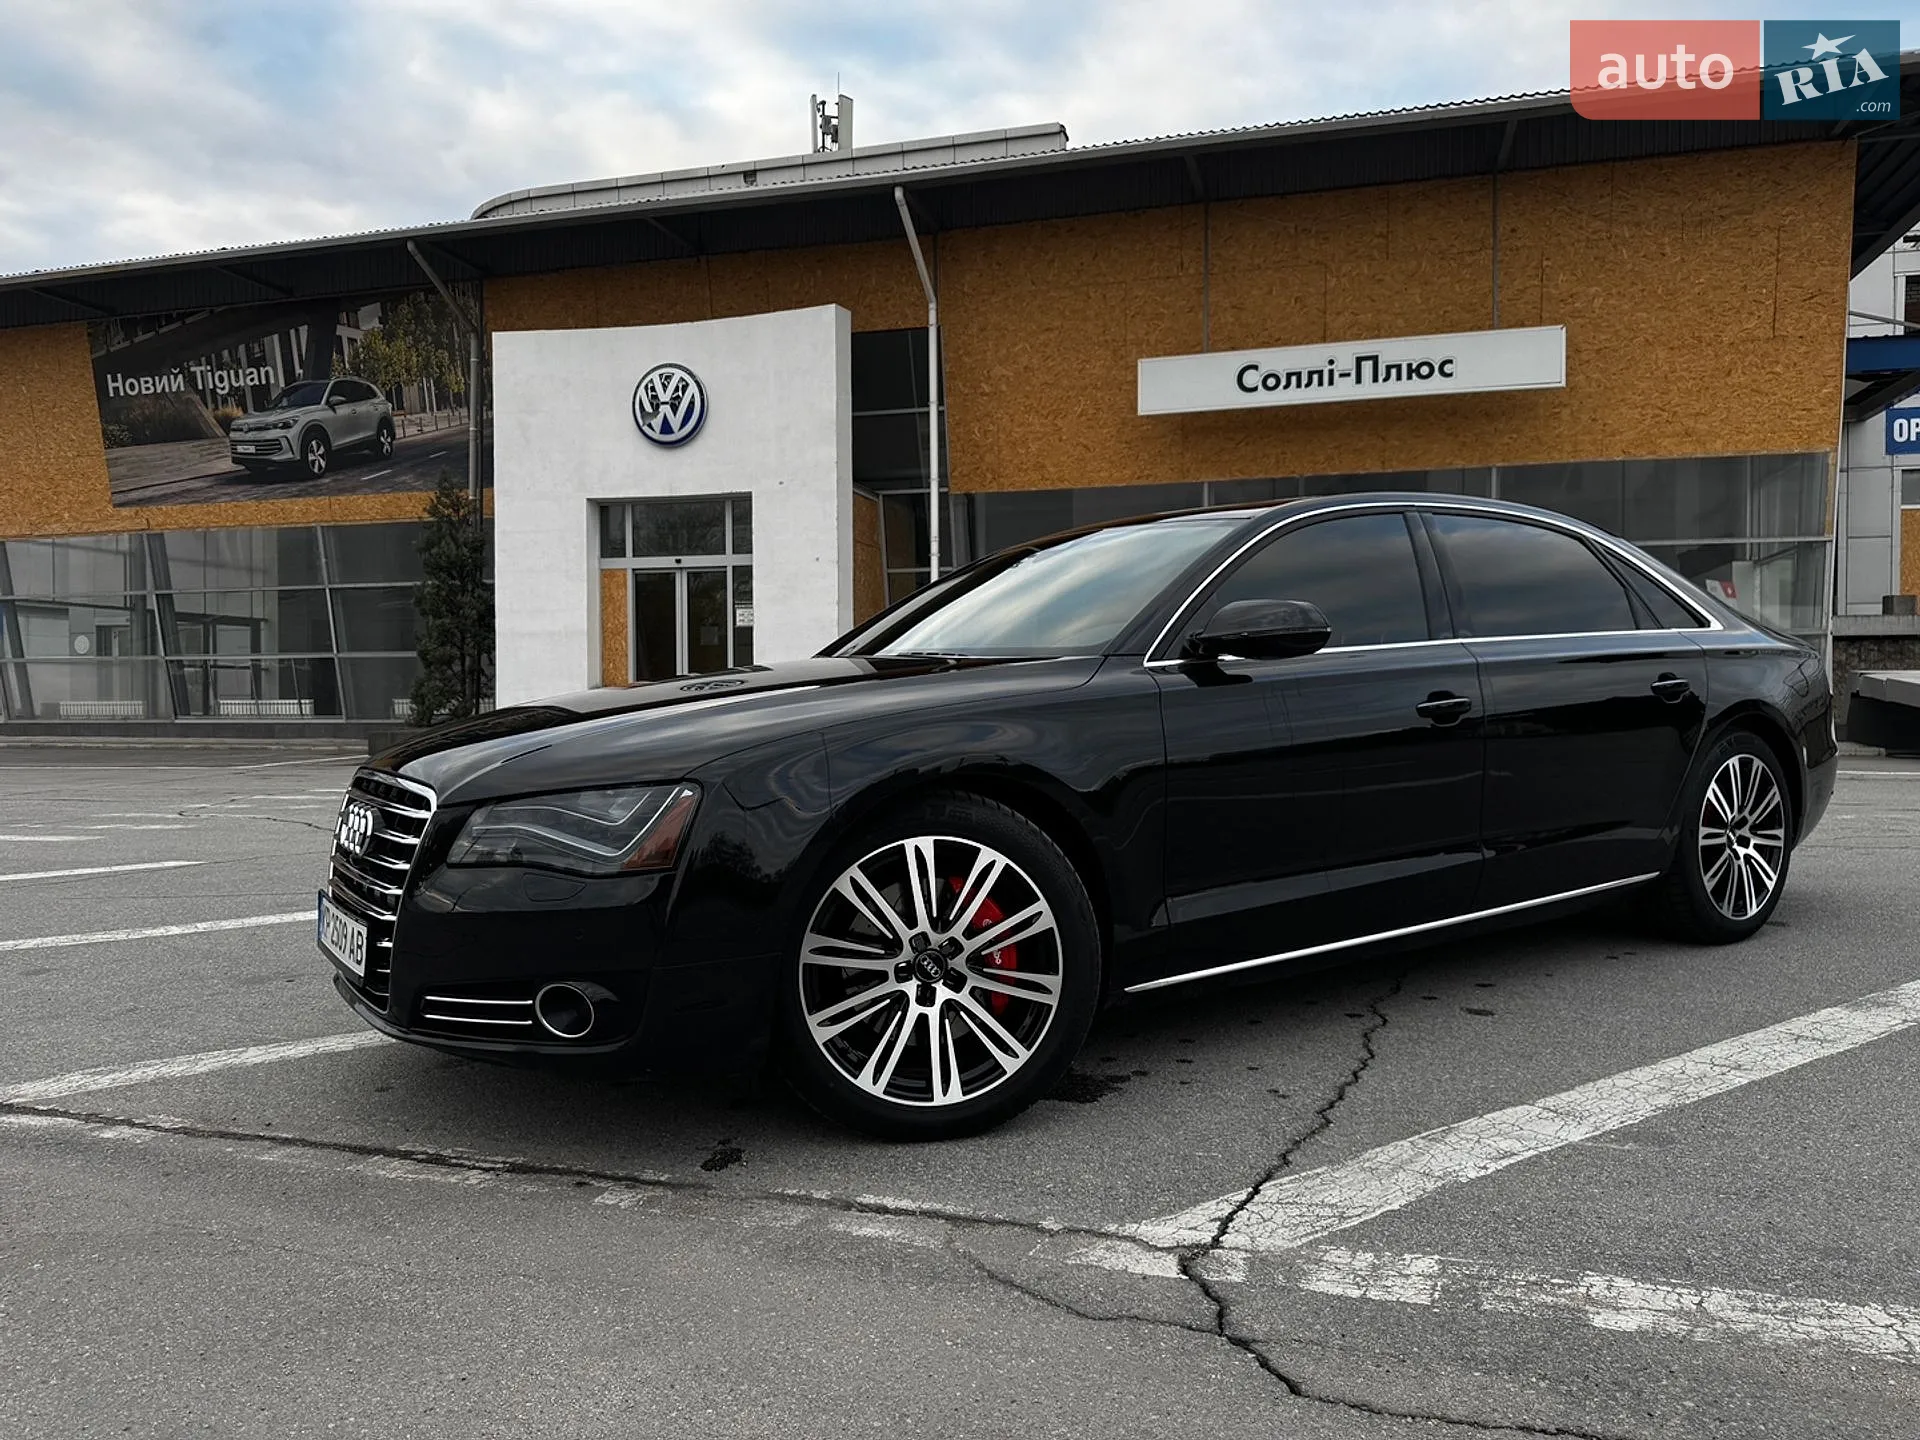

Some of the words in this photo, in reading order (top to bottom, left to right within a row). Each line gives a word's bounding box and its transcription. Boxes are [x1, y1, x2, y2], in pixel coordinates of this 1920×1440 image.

[106, 367, 186, 398] Новий
[190, 365, 275, 394] Tiguan
[1236, 354, 1454, 393] Соллі-Плюс
